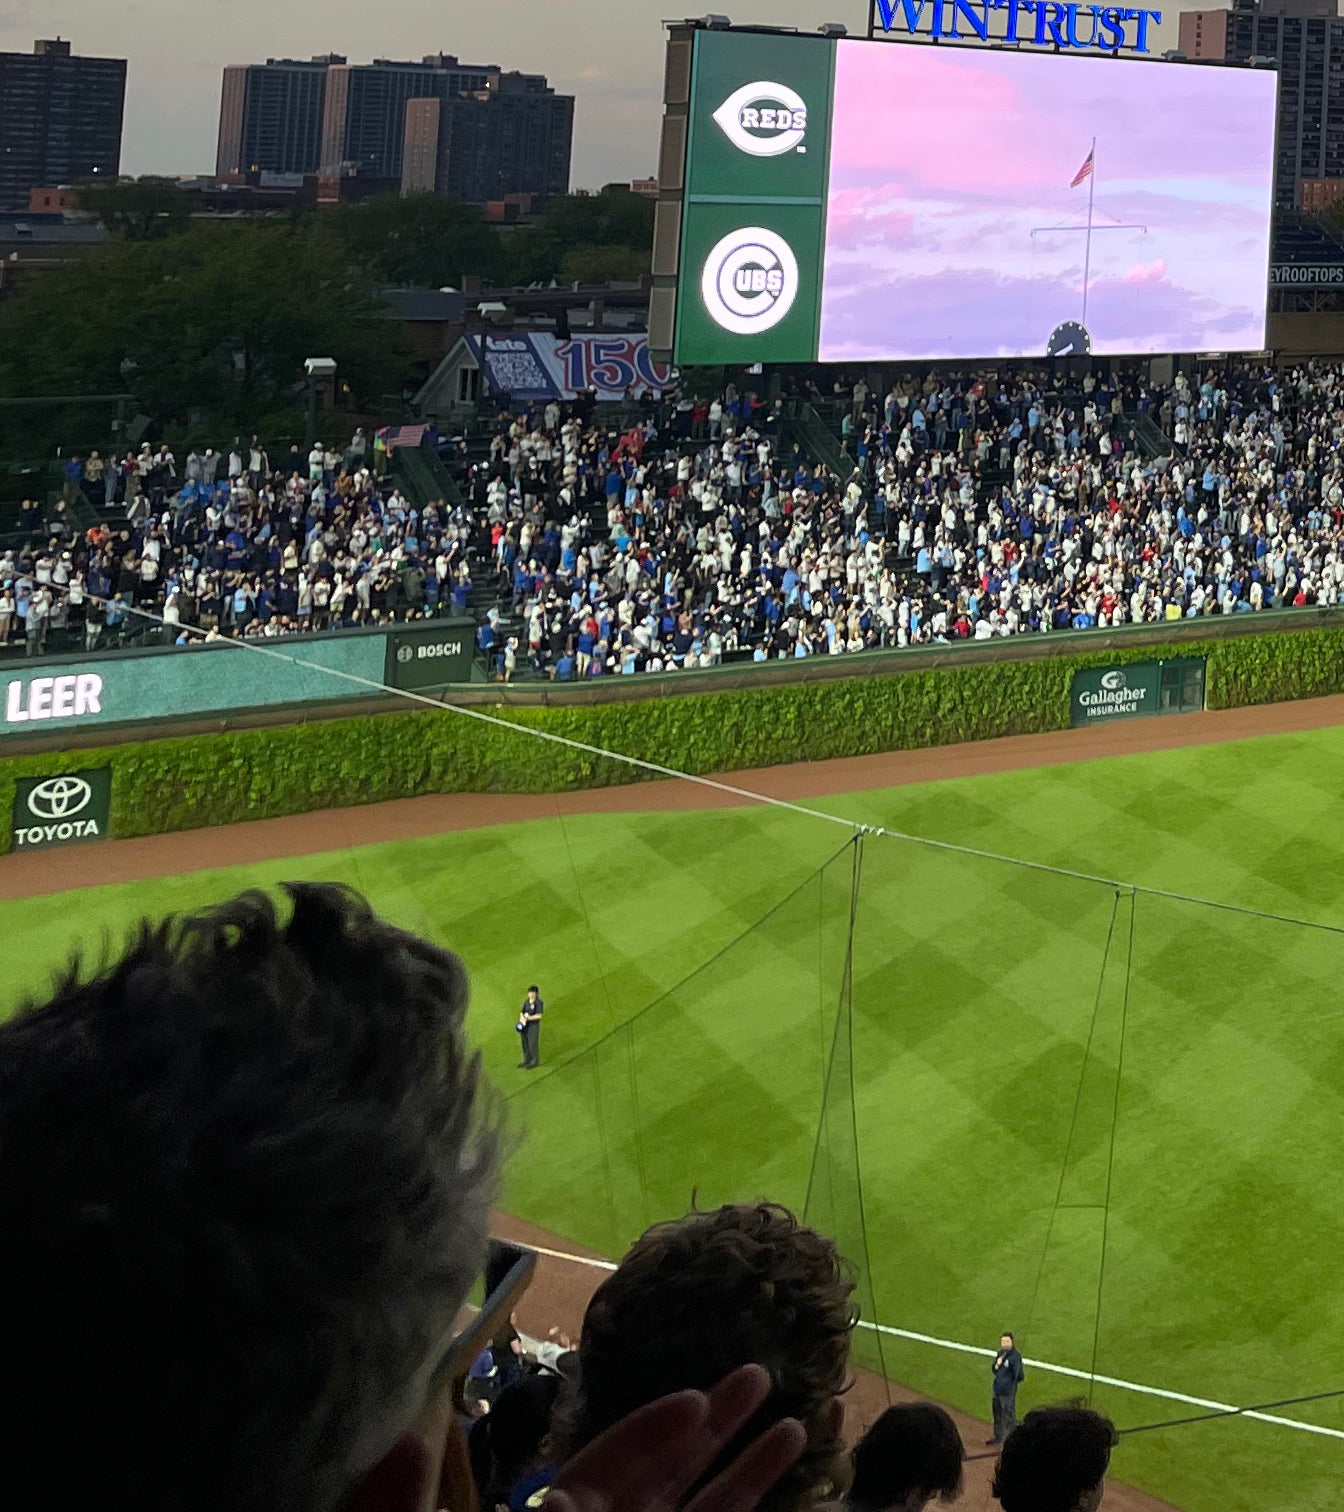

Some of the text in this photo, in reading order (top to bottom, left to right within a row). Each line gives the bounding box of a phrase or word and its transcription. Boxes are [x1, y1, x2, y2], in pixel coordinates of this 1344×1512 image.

[741, 108, 807, 130] REDS
[418, 641, 461, 659] BOSCH
[5, 672, 103, 723] LEER
[1079, 687, 1146, 706] Gallagher
[1087, 701, 1137, 717] INSURANCE
[14, 819, 99, 845] TOYOTA
